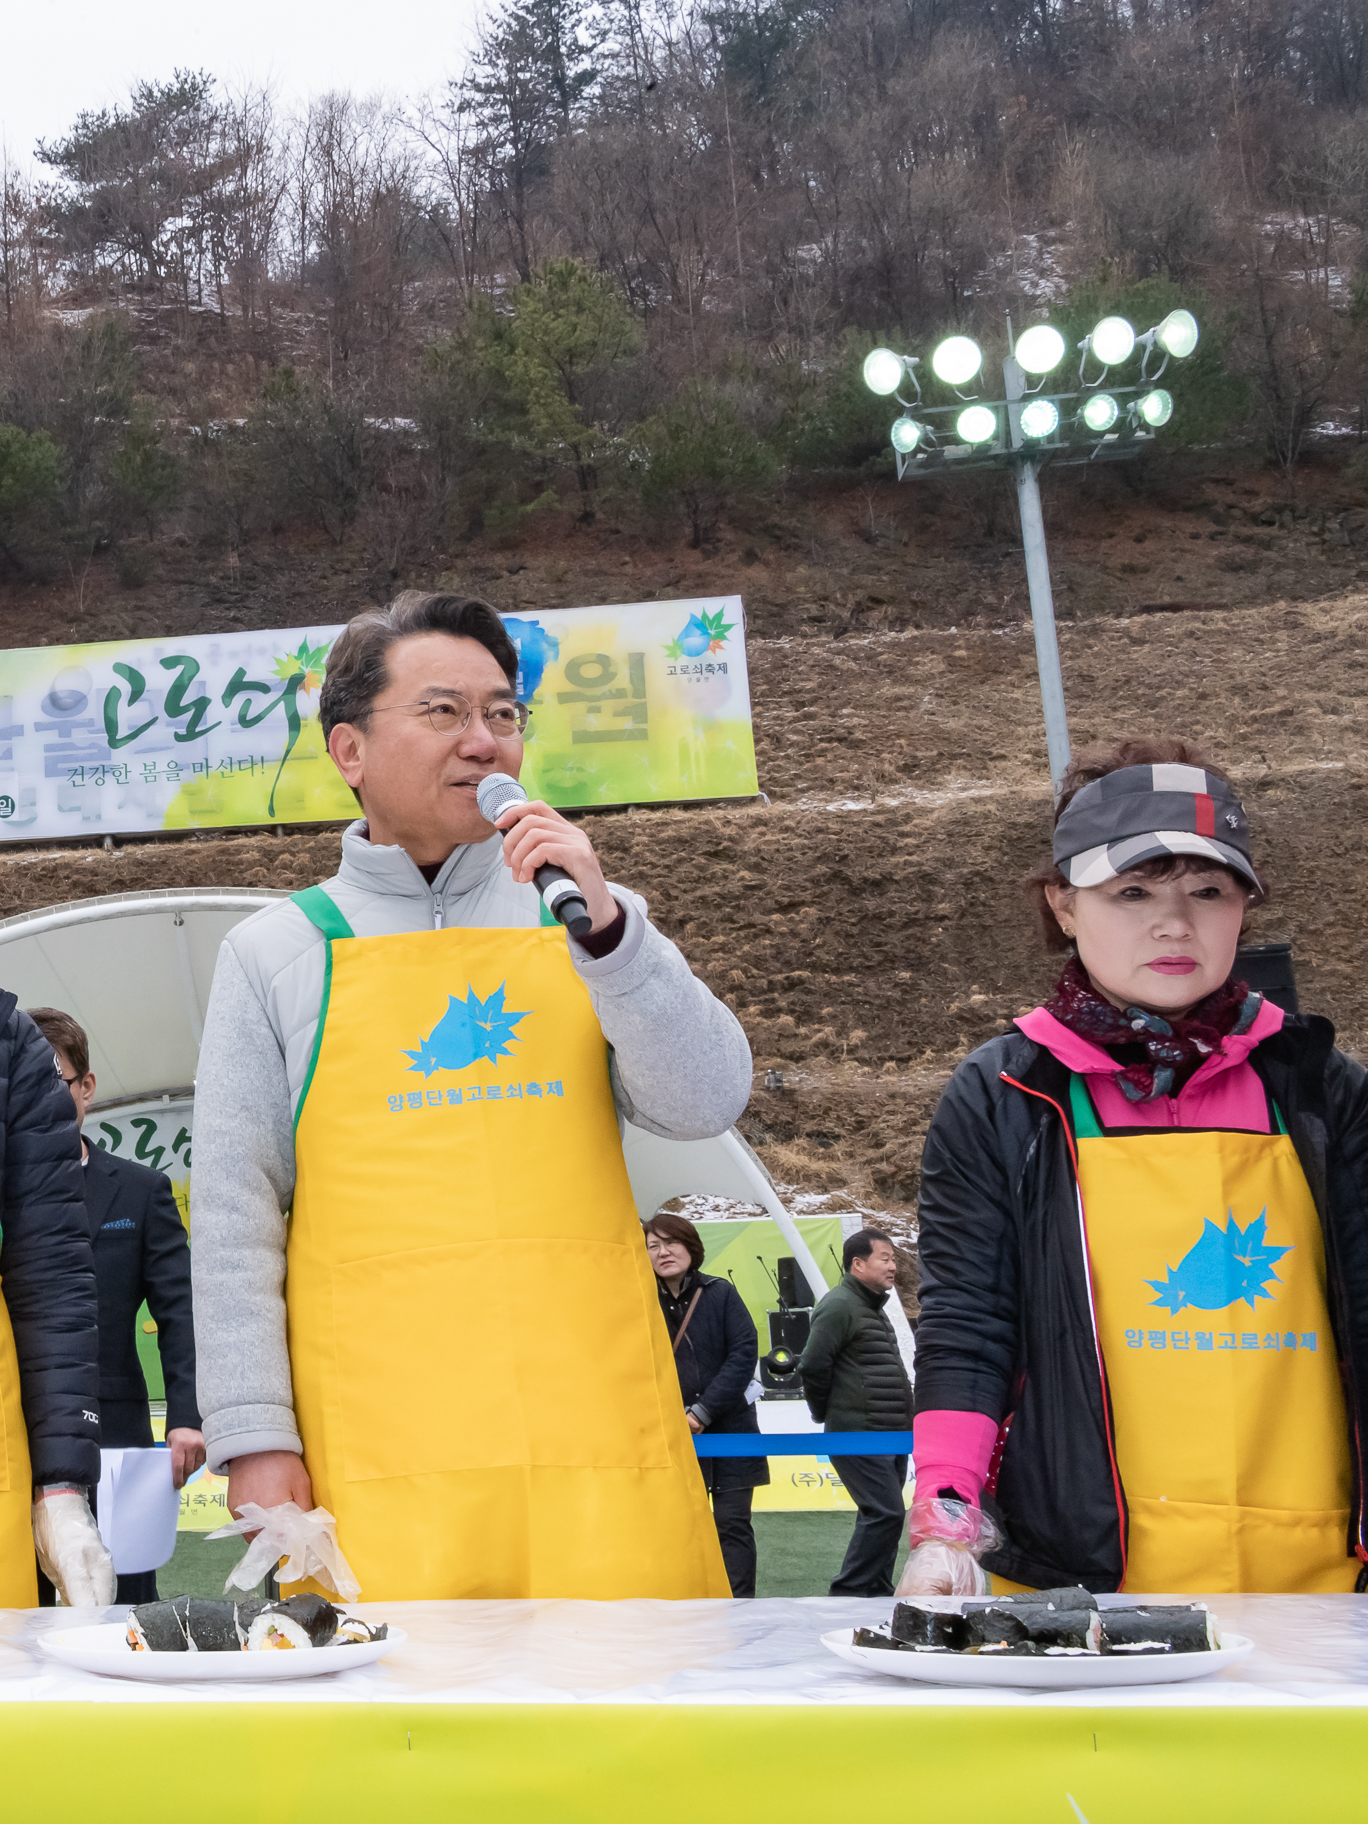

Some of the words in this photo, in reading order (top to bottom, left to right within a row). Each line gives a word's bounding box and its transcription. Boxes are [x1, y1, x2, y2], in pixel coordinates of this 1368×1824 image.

[666, 662, 728, 676] 고로쇠축제
[66, 763, 132, 788] 건강한
[139, 760, 183, 784] 봄을
[192, 755, 266, 780] 마신다!
[387, 1080, 565, 1112] 양평단월고로쇠축제
[1124, 1328, 1318, 1352] 양평단월고로쇠축제
